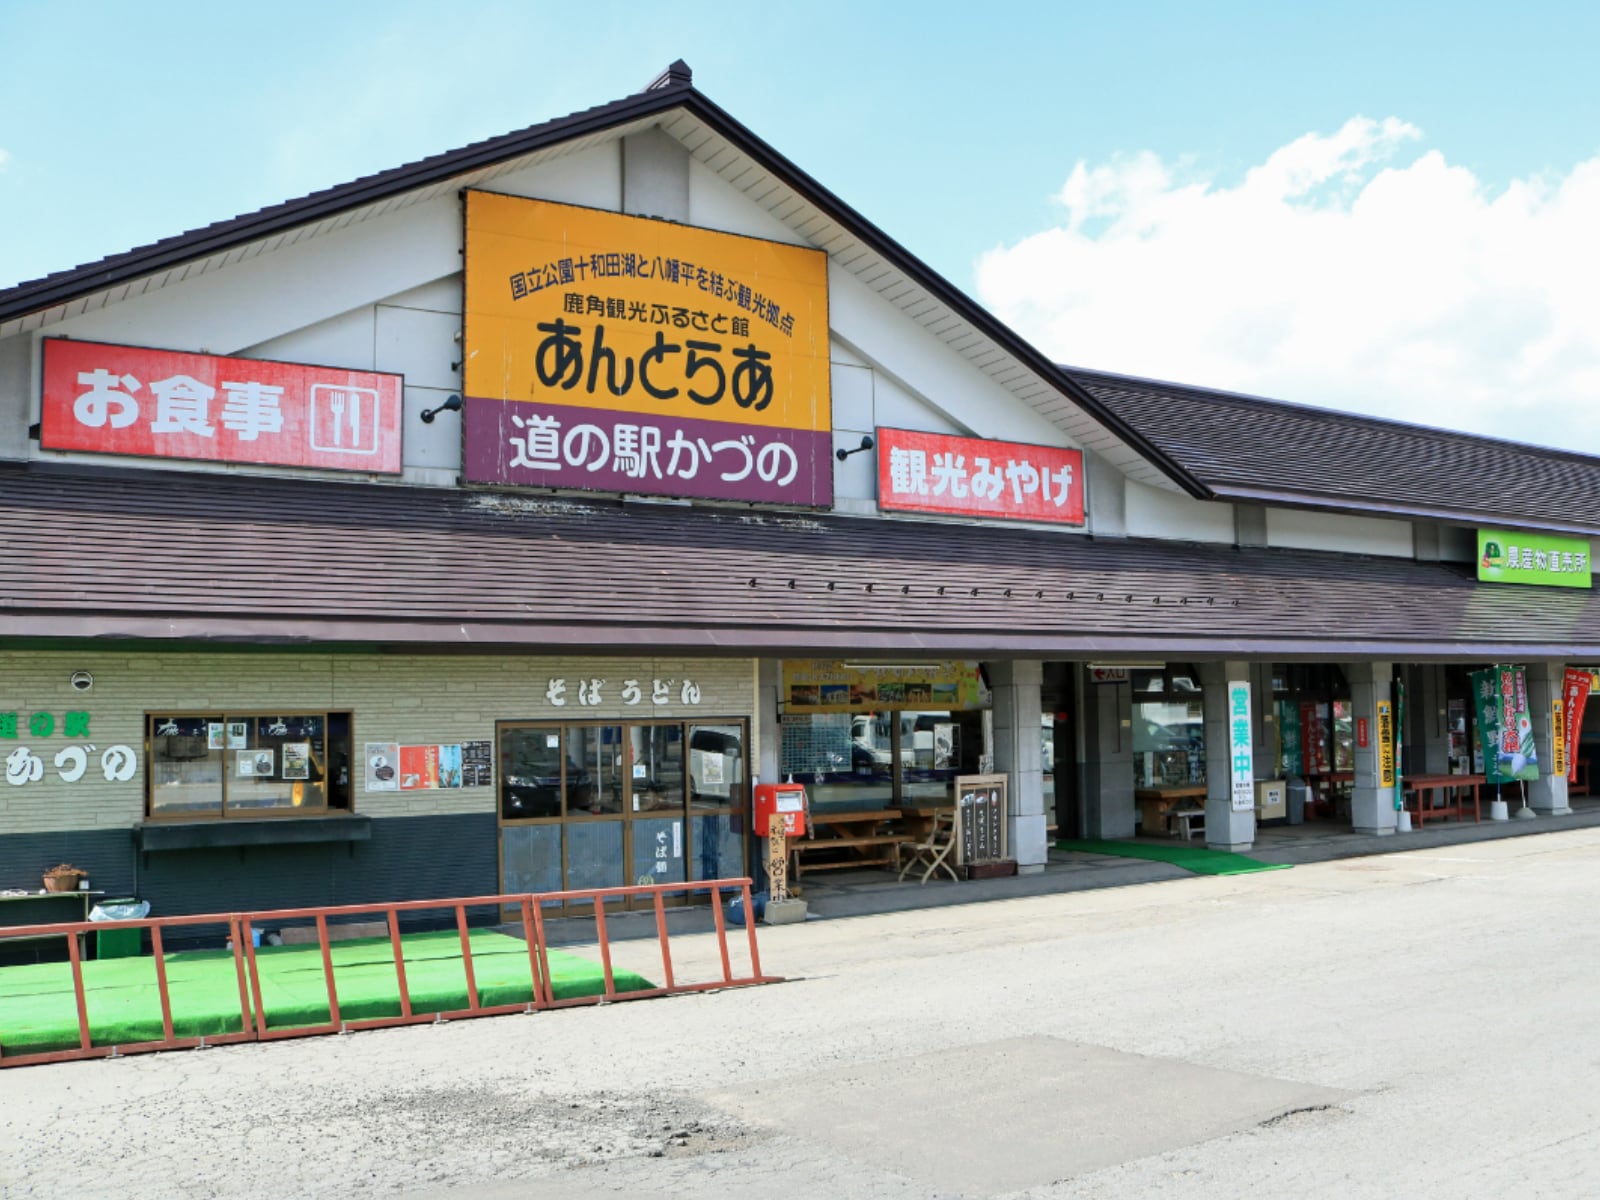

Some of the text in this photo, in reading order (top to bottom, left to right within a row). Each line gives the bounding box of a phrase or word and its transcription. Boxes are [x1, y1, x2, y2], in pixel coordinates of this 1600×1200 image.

[510, 253, 795, 337] 国立公園十和田湖と八幡平を結ぶ観光拠点
[563, 292, 750, 338] 鹿角観光ふるさと館
[535, 317, 774, 411] あんとらあ
[72, 367, 285, 441] お食事
[509, 413, 799, 486] 道の駅かづの
[889, 445, 1073, 507] 観光みやげ
[546, 678, 701, 706] そば うどん
[6, 743, 137, 785] かづの
[1231, 687, 1251, 781] 営業中
